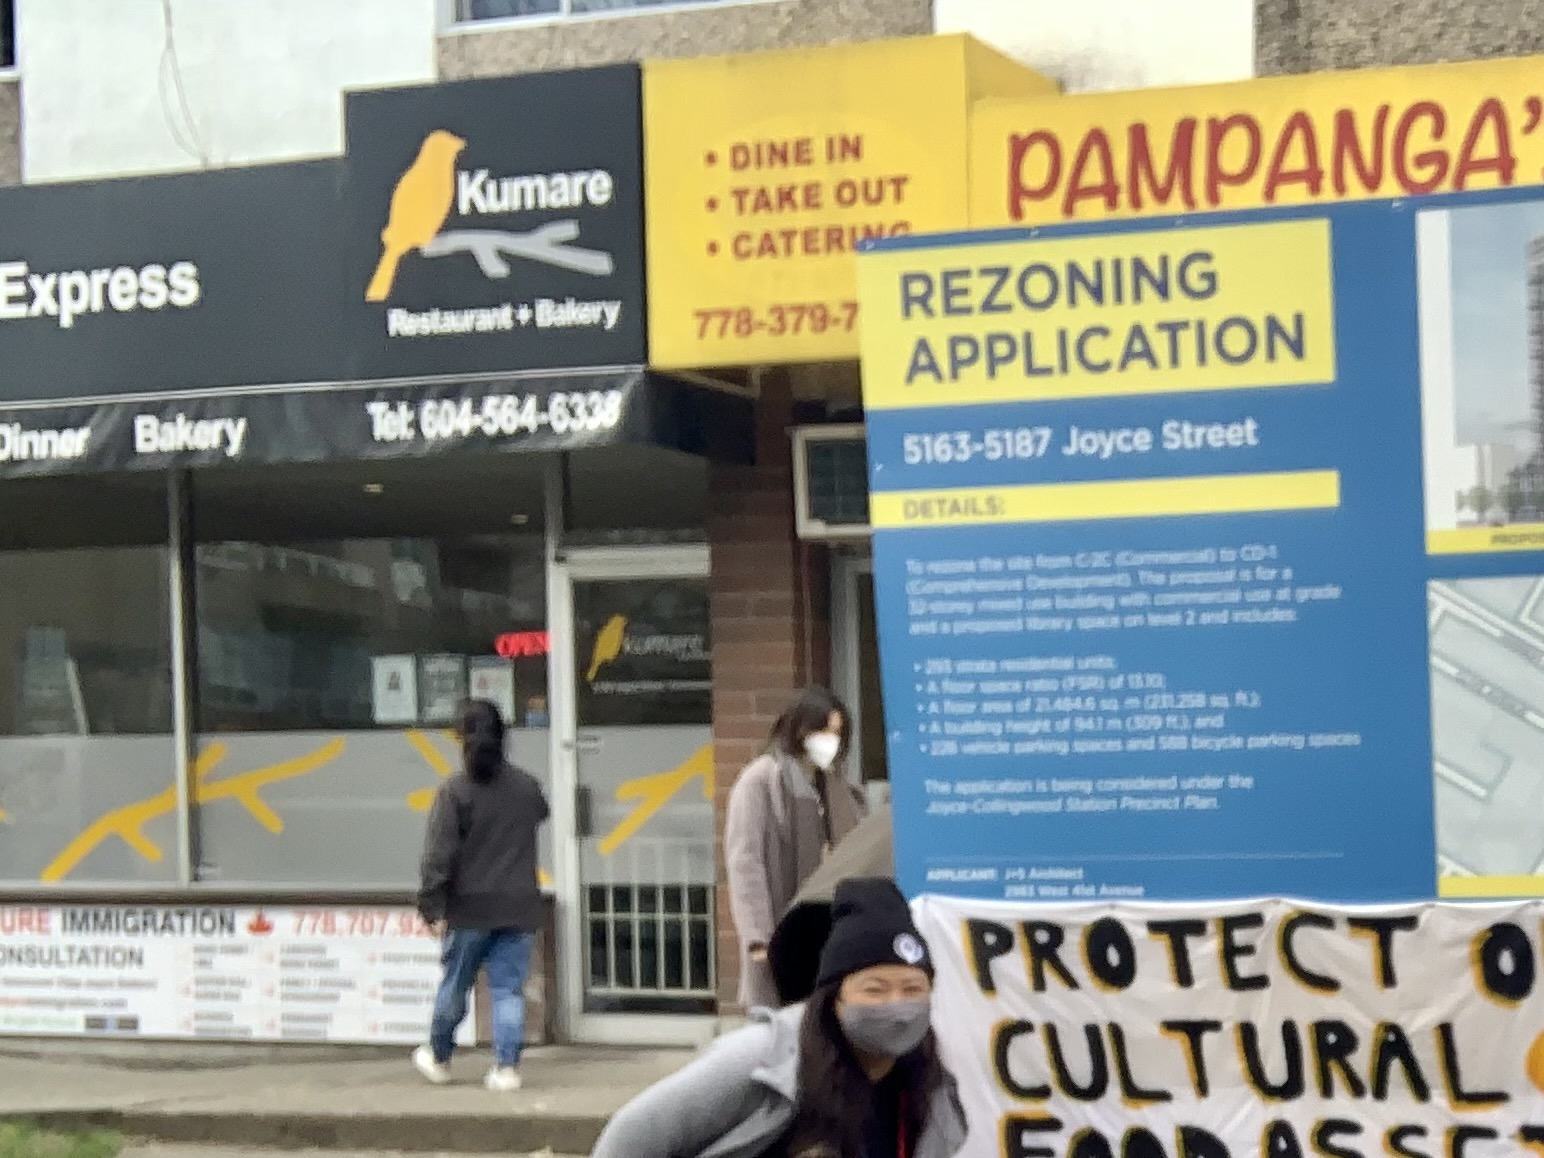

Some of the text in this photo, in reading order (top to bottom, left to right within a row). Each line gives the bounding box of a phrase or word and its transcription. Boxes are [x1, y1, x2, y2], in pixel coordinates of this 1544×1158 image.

[730, 133, 863, 171] DINE IN
[457, 168, 613, 215] Kumare
[730, 174, 909, 216] TAKE OUT
[0, 259, 201, 329] Express
[900, 249, 1219, 321] REZONING
[386, 302, 513, 337] Restaurant
[534, 296, 622, 331] Bakery
[904, 311, 1308, 386] APPLICATION
[134, 411, 247, 457] Bakery
[366, 389, 623, 442] Tel: 604-564-6338
[903, 415, 1260, 465] 5163-5187 Joyce Street
[61, 907, 237, 936] IMMIGRATION
[962, 910, 1421, 996] PROTECT
[990, 1017, 1512, 1111] CULTURAL
